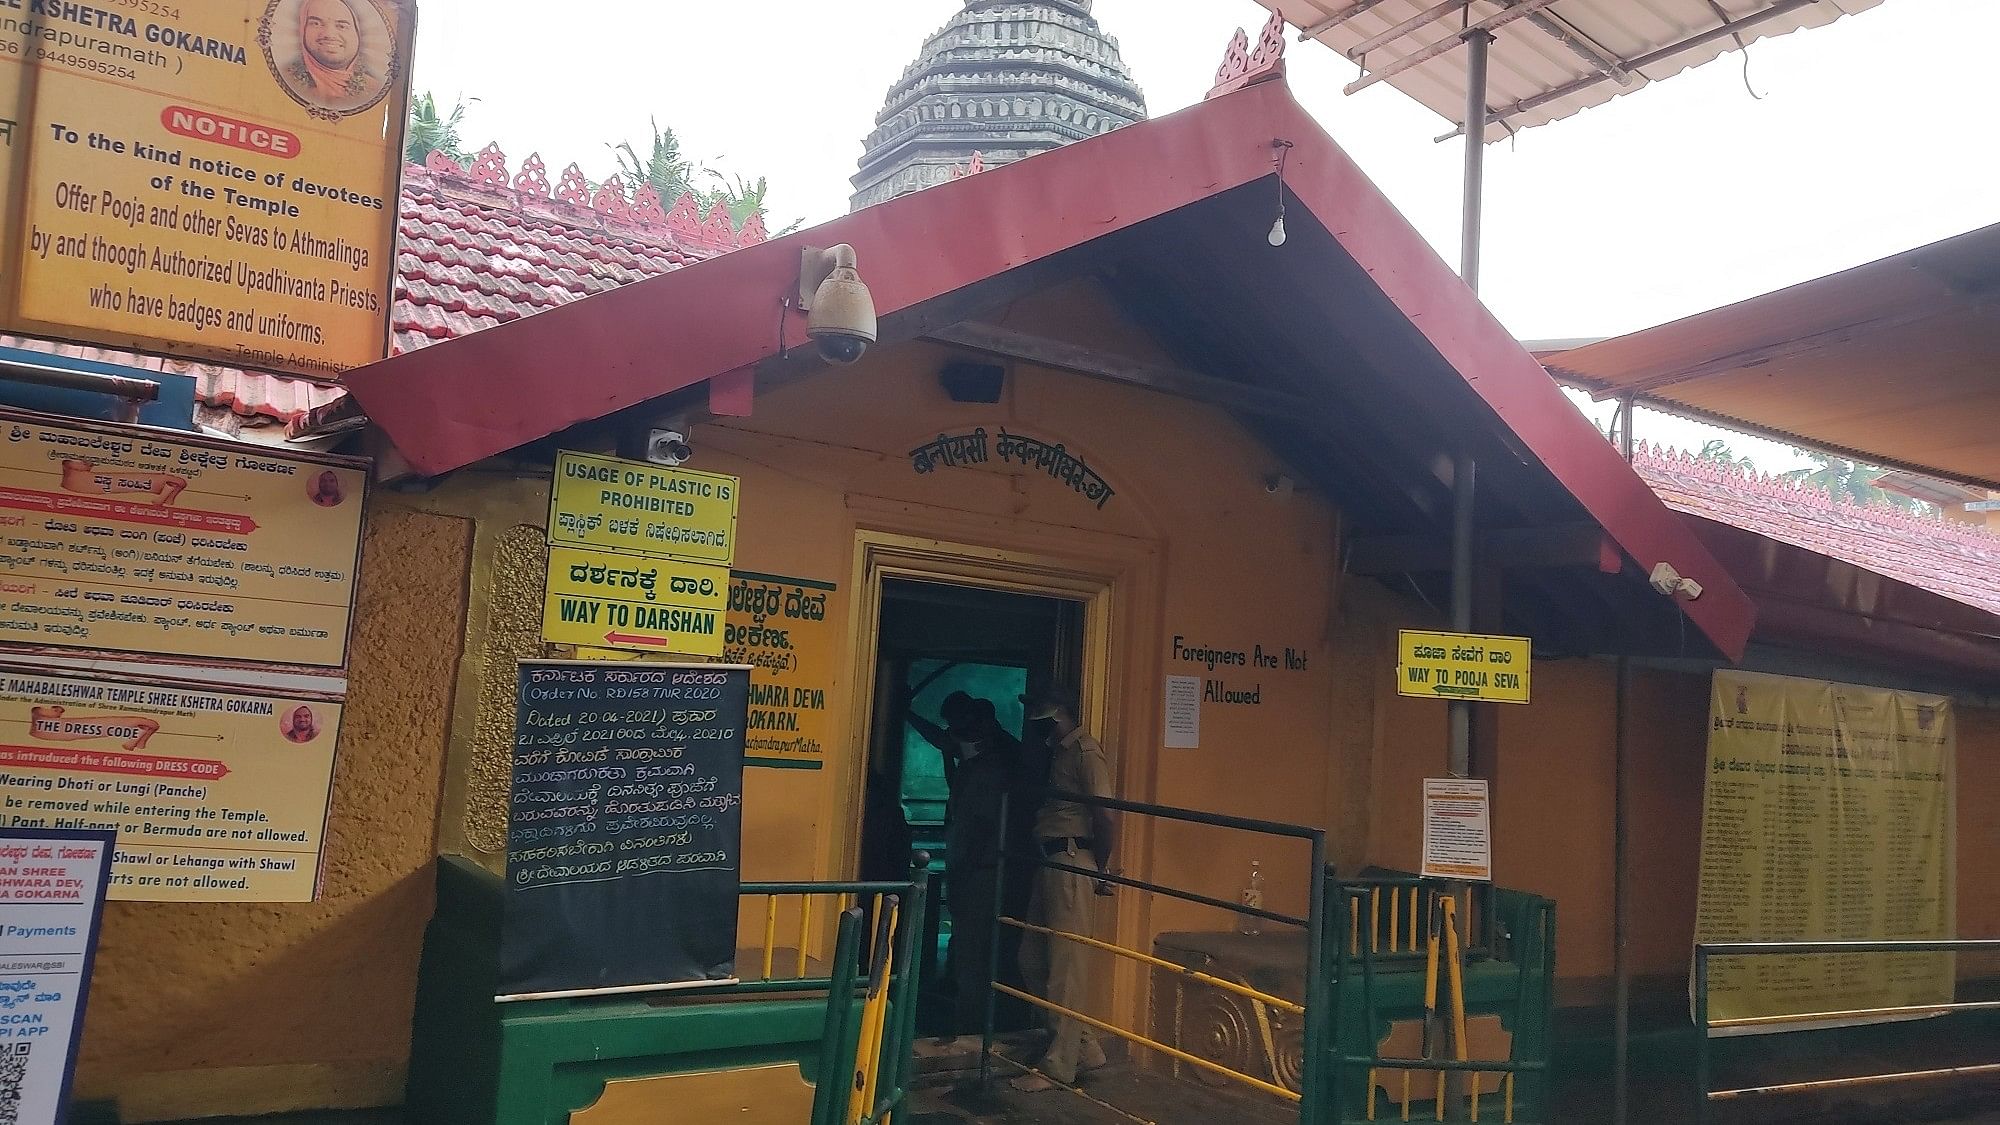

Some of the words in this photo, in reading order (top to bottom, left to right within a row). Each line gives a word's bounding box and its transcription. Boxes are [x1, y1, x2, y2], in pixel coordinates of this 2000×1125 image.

[0, 18, 167, 68] ndrapuramath
[146, 23, 247, 65] GOKARNA
[36, 48, 136, 80] 9449595254
[171, 111, 289, 153] NOTICE
[51, 123, 79, 144] To
[88, 130, 126, 154] the
[134, 141, 181, 167] kind
[189, 156, 257, 182] notice
[264, 172, 287, 189] of
[292, 177, 384, 211] devotees
[150, 174, 172, 192] of
[181, 179, 216, 200] the
[224, 188, 300, 219] Temple
[55, 182, 97, 214] Offer
[101, 190, 145, 228] Pooja
[150, 200, 178, 231] and
[182, 206, 222, 239] other
[225, 218, 268, 249] Sevas
[273, 226, 287, 251] to
[290, 228, 369, 271] Athmalinga
[31, 228, 51, 259] by
[57, 232, 86, 260] and
[91, 237, 146, 274] thoogh
[151, 246, 232, 285] Authorized
[237, 262, 325, 302] Upadhivanta
[330, 280, 381, 317] Priests,
[90, 285, 121, 311] who
[126, 287, 163, 317] have
[168, 294, 222, 331] badges
[227, 307, 254, 333] and
[258, 315, 325, 346] uniforms.
[236, 343, 284, 362] Temple
[140, 442, 172, 459] ದೇವ
[235, 457, 297, 476] ಗೋಕರ್ಣ
[565, 461, 619, 484] USAGE
[624, 472, 645, 487] OF
[650, 474, 711, 497] PLASTIC
[717, 485, 730, 500] IS
[601, 490, 694, 517] PROHIBITED
[570, 561, 658, 601] ದರ್ಶನಕ್ಕೆ
[670, 575, 719, 597] ದಾರಿ.
[560, 598, 600, 624] WAY
[607, 603, 629, 627] TO
[634, 606, 715, 635] DARSHAN
[784, 588, 827, 622] ದೇವ
[1173, 635, 1246, 671] Foreigners
[1253, 644, 1278, 669] Are
[1285, 647, 1308, 671] Not
[1489, 650, 1512, 664] ದಾರಿ
[1204, 679, 1261, 704] Allowed
[1408, 667, 1430, 683] WAY
[1436, 668, 1449, 684] TO
[1455, 670, 1488, 687] POOJA
[1494, 673, 1519, 689] SEVA
[8, 679, 104, 699] MAHABALESHWAR
[107, 688, 145, 703] TEMPLE
[147, 691, 178, 708] SHREE
[181, 695, 223, 712] KSHETRA
[227, 699, 273, 716] GOKARNA
[652, 687, 681, 700] TNR
[793, 687, 825, 710] DEVA
[37, 720, 60, 732] THE
[65, 723, 102, 735] DRESS
[107, 727, 139, 739] CODE
[526, 709, 571, 727] Dated
[81, 754, 100, 765] the
[102, 757, 153, 771] following
[156, 762, 188, 773] DRESS
[191, 765, 219, 775] CODE
[0, 773, 52, 790] Wearing
[57, 777, 94, 790] Dhoti
[98, 783, 112, 792] or
[116, 781, 150, 797] Lungi
[153, 782, 207, 800] (Panche)
[5, 795, 23, 807] be
[28, 799, 89, 811] removed
[94, 801, 130, 814] while
[135, 805, 191, 821] entering
[194, 807, 216, 820] the
[221, 808, 270, 823] Temple.
[125, 823, 139, 834] or
[143, 823, 202, 838] Bermuda
[206, 827, 227, 839] are
[230, 827, 253, 840] not
[255, 827, 309, 843] allowed.
[22, 867, 66, 876] SHREE
[112, 851, 152, 865] Shawl
[155, 855, 170, 866] or
[172, 855, 226, 870] Lehanga
[228, 856, 256, 870] with
[259, 858, 297, 871] Shawl
[15, 890, 80, 899] GOKARNA
[56, 879, 84, 888] DEV,
[139, 876, 162, 887] are
[166, 876, 190, 888] not
[193, 875, 250, 891] allowed.
[7, 925, 77, 939] Payments
[0, 1014, 42, 1024] SCAN
[17, 1026, 49, 1037] APP
